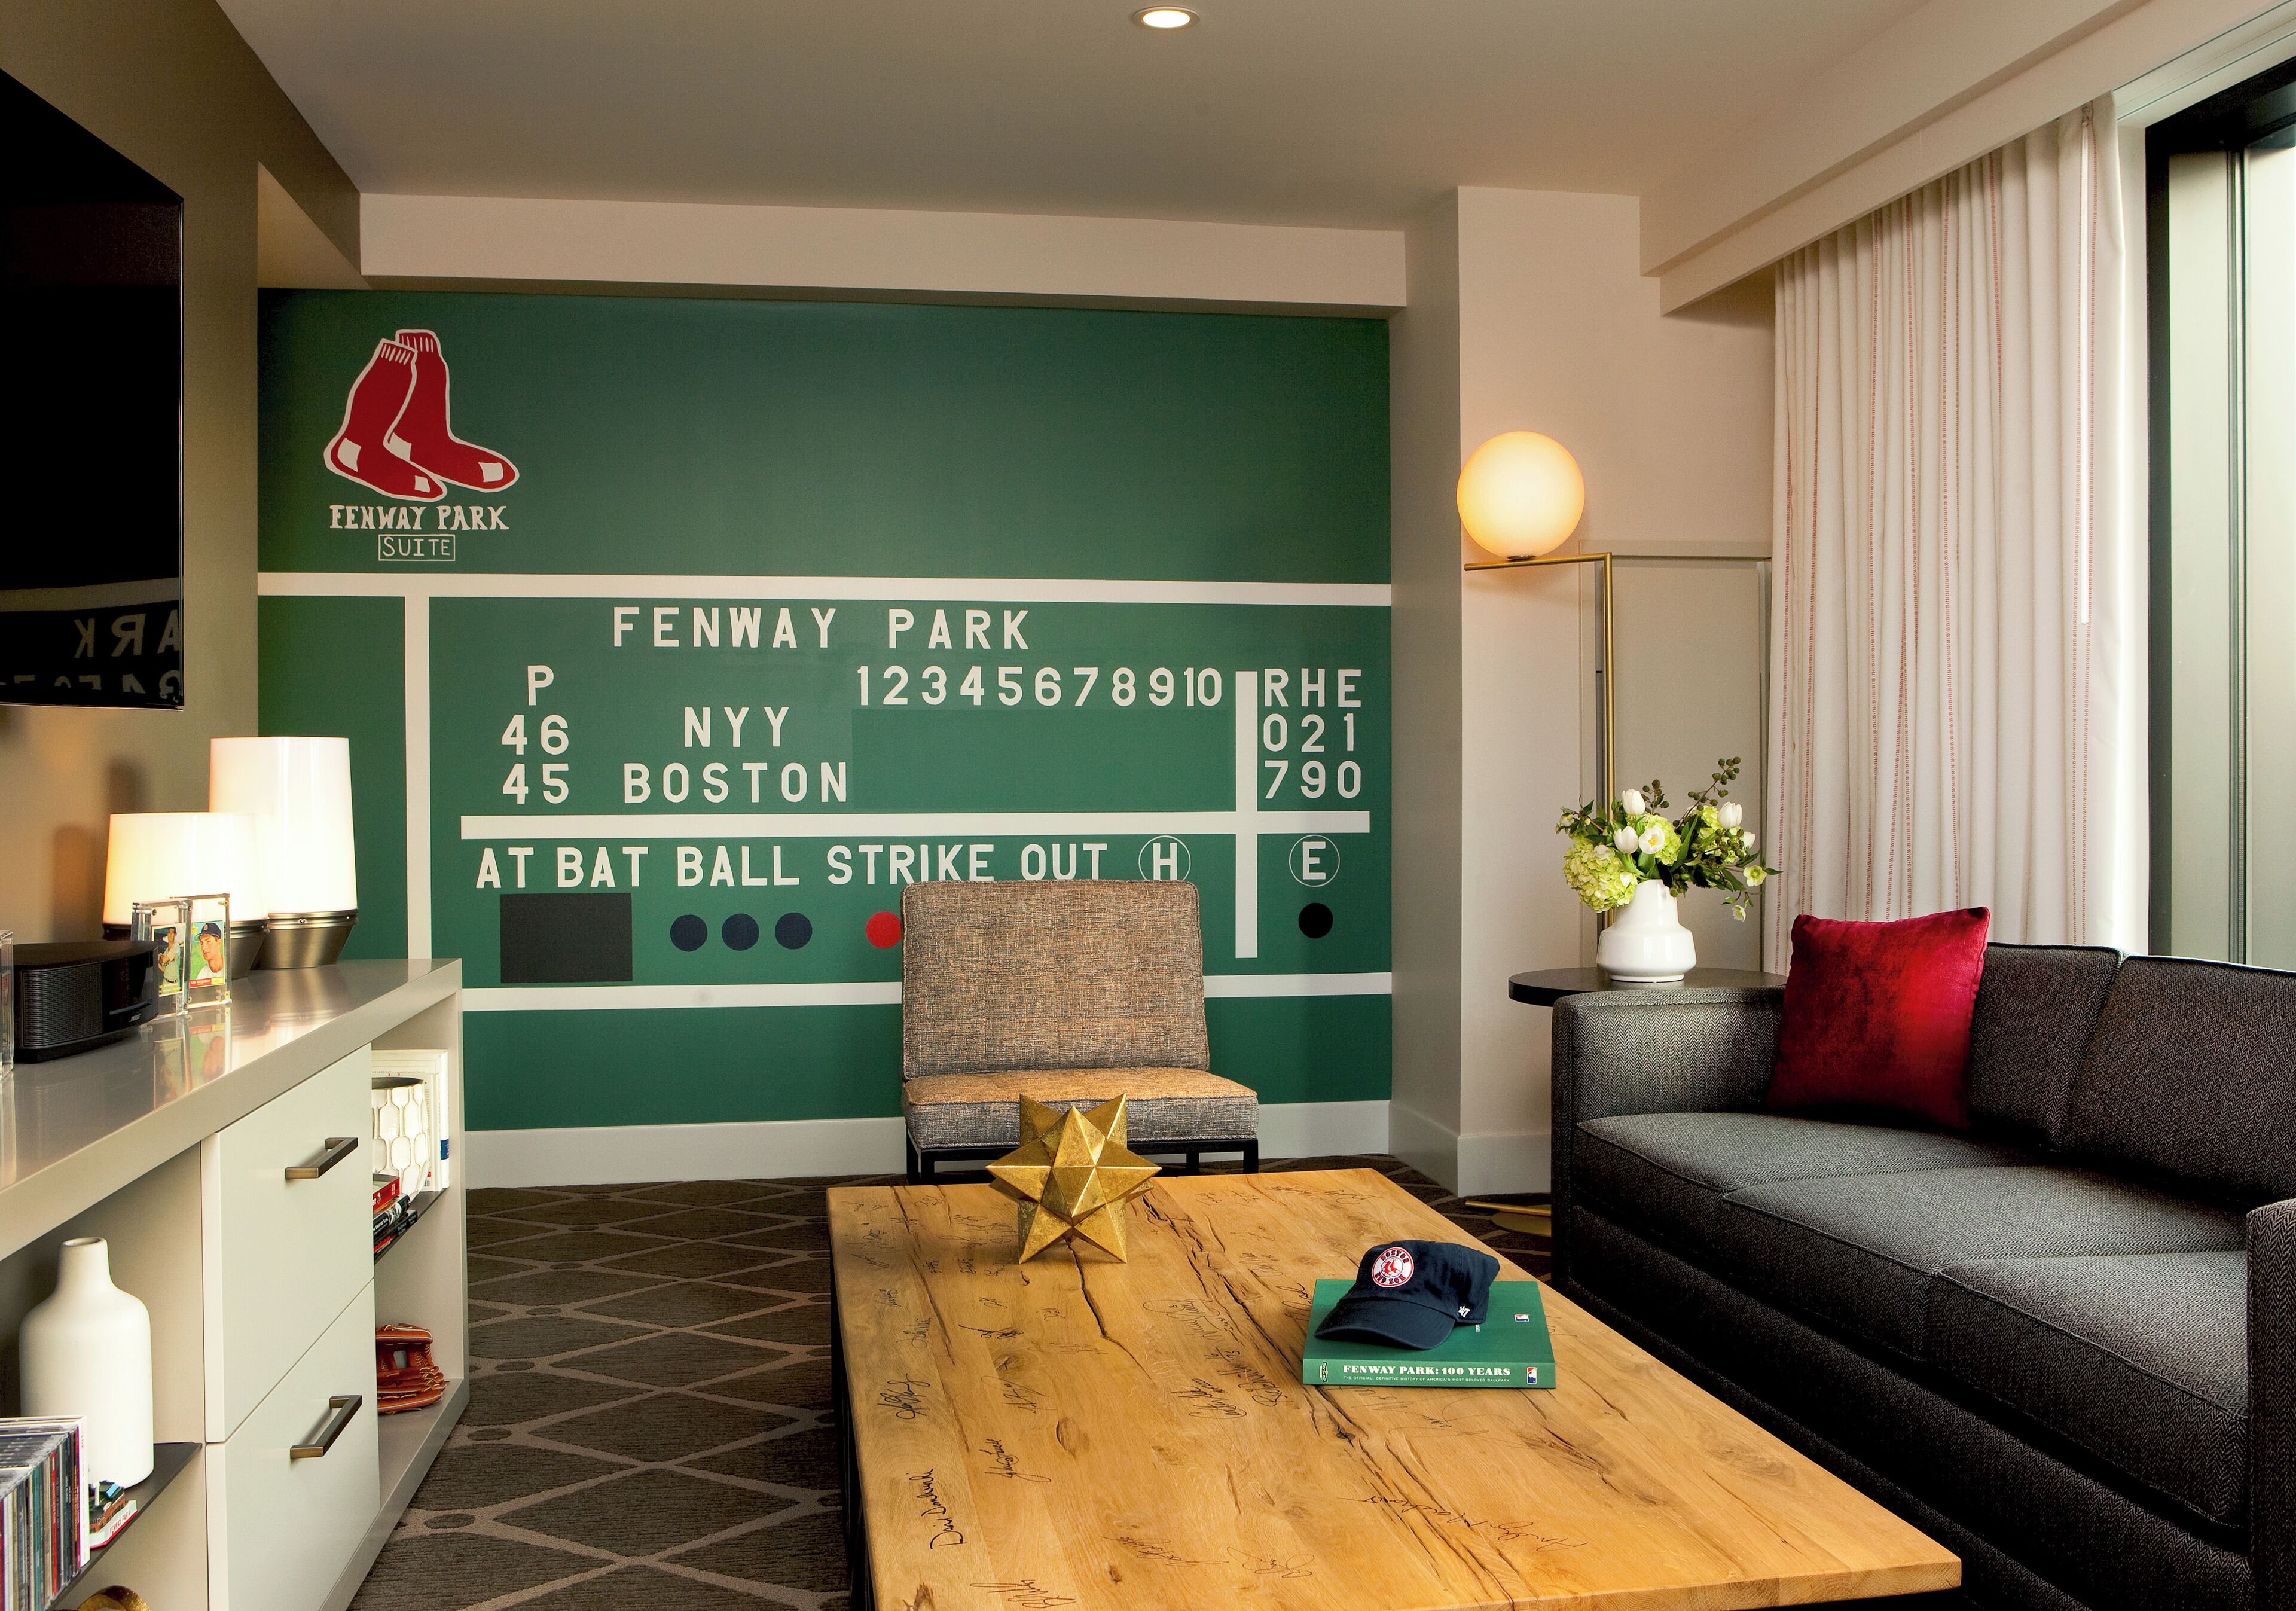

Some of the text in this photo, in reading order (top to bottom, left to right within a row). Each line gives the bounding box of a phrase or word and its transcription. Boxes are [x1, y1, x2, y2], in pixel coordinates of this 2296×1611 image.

[329, 504, 509, 531] FENWAY PARK
[383, 536, 451, 557] SUITE
[613, 606, 1029, 649] FENWAY PARK
[527, 664, 554, 706] P
[502, 714, 569, 755] 46
[684, 706, 790, 747] NYY
[502, 763, 569, 804] 45
[624, 762, 847, 804] BOSTON
[475, 846, 649, 889] AT BAT
[677, 845, 799, 887] BALL
[826, 844, 995, 884] STRIKE
[1021, 843, 1107, 880] OUT
[1153, 842, 1178, 880] H
[1302, 841, 1326, 880] E
[1380, 1250, 1410, 1263] BOSTON
[1375, 1271, 1406, 1284] RED SOX
[1343, 1365, 1511, 1376] FENWAY PARK: 100 YEARS
